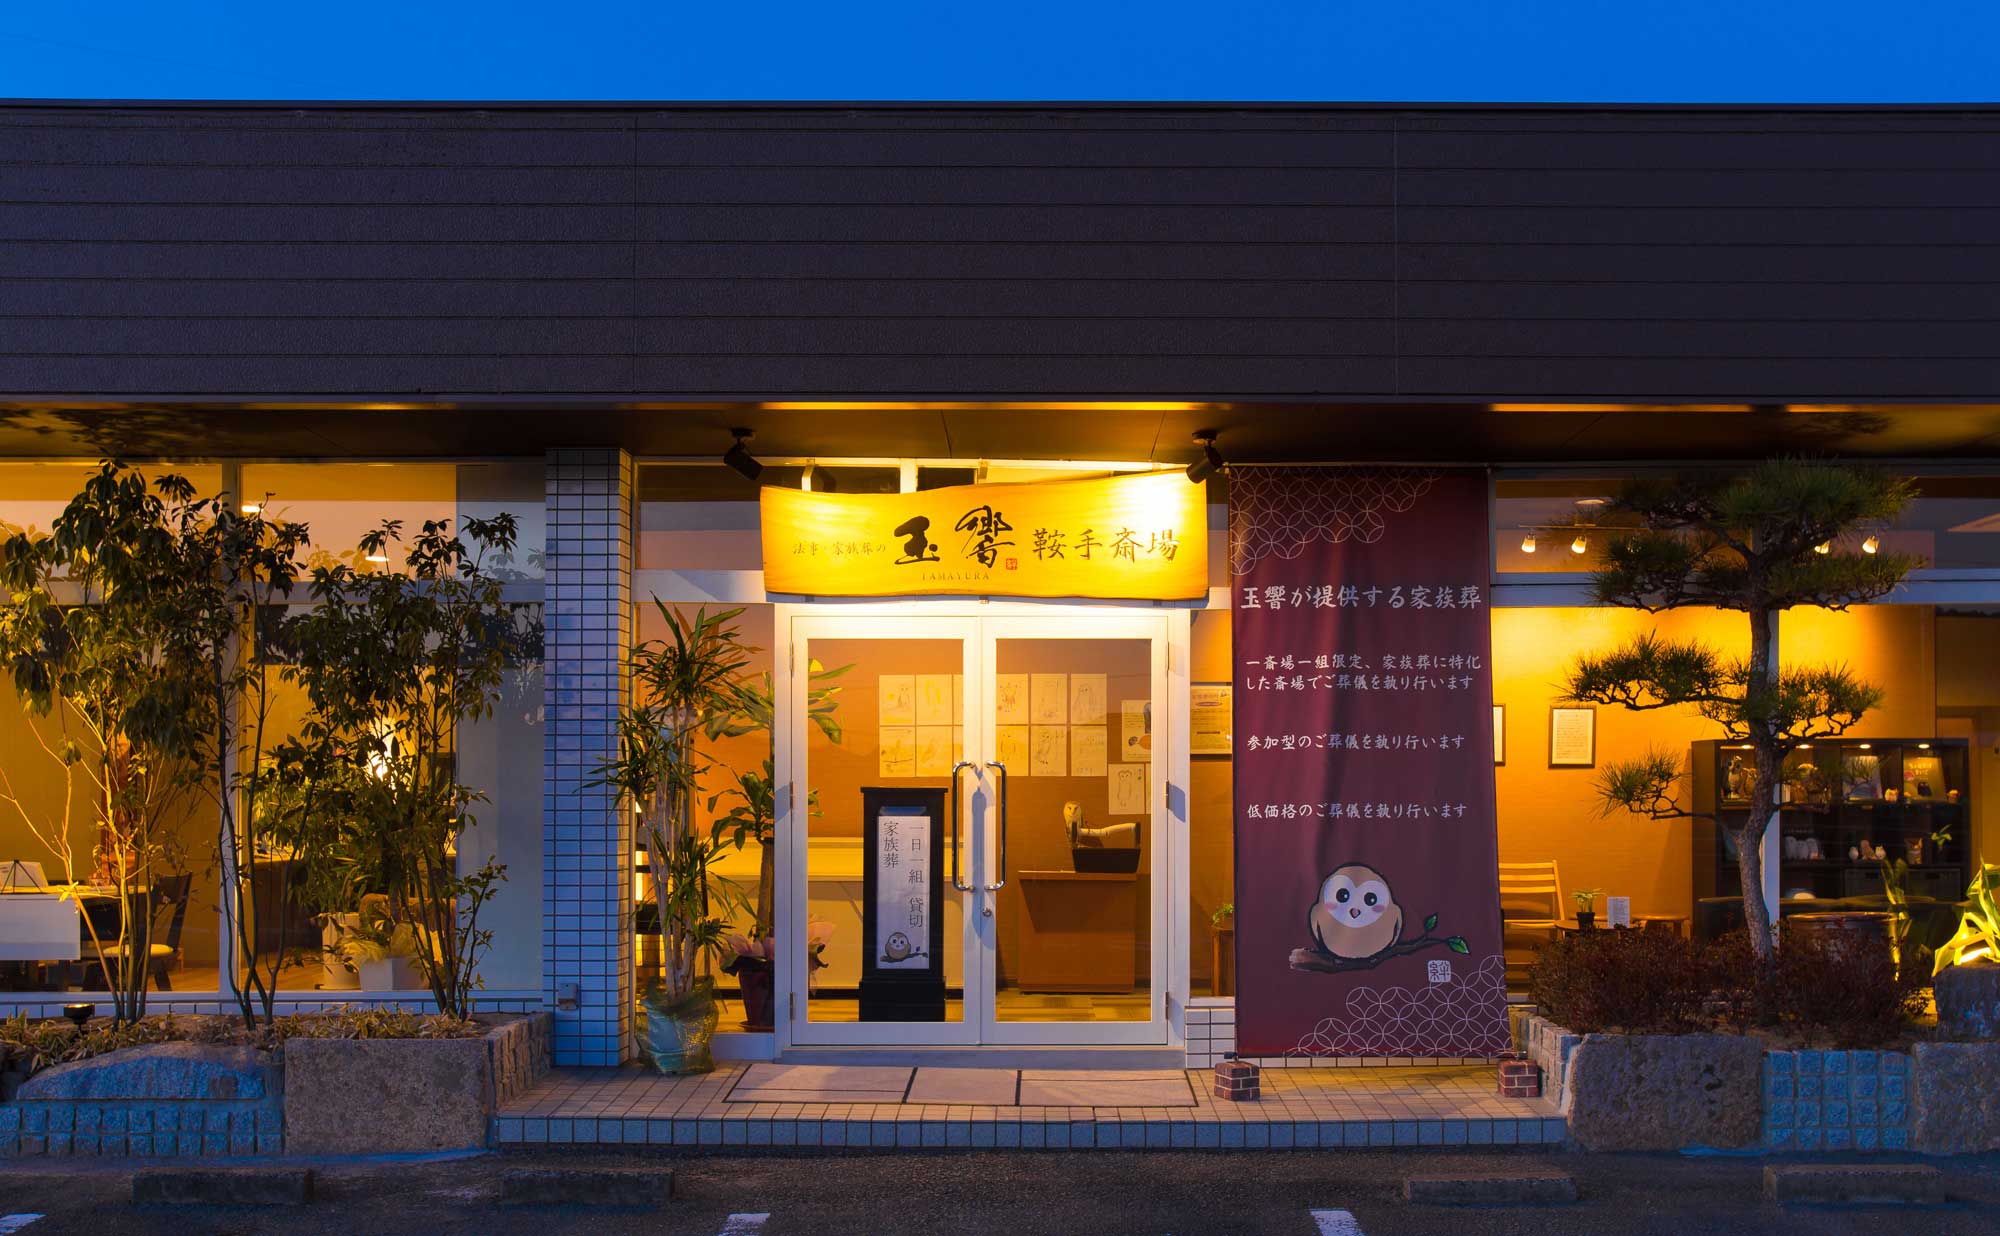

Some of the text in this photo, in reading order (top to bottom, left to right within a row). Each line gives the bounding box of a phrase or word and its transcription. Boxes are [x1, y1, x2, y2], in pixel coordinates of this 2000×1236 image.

[894, 504, 1016, 569] 玉響
[1032, 526, 1180, 565] 鞍手斎場
[1240, 585, 1482, 610] 玉響が提供する家族葬
[1246, 654, 1481, 671] 一斎場一組限定、家族葬に特化
[1246, 674, 1473, 691] した斎場でご葬儀を執り行います
[1247, 733, 1465, 751] 参加型のご葬儀を執り行います
[1247, 802, 1468, 820] 低価格のご葬儀を執り行います
[882, 820, 899, 869] 家族葬
[908, 825, 924, 928] 一日一組 貸切
